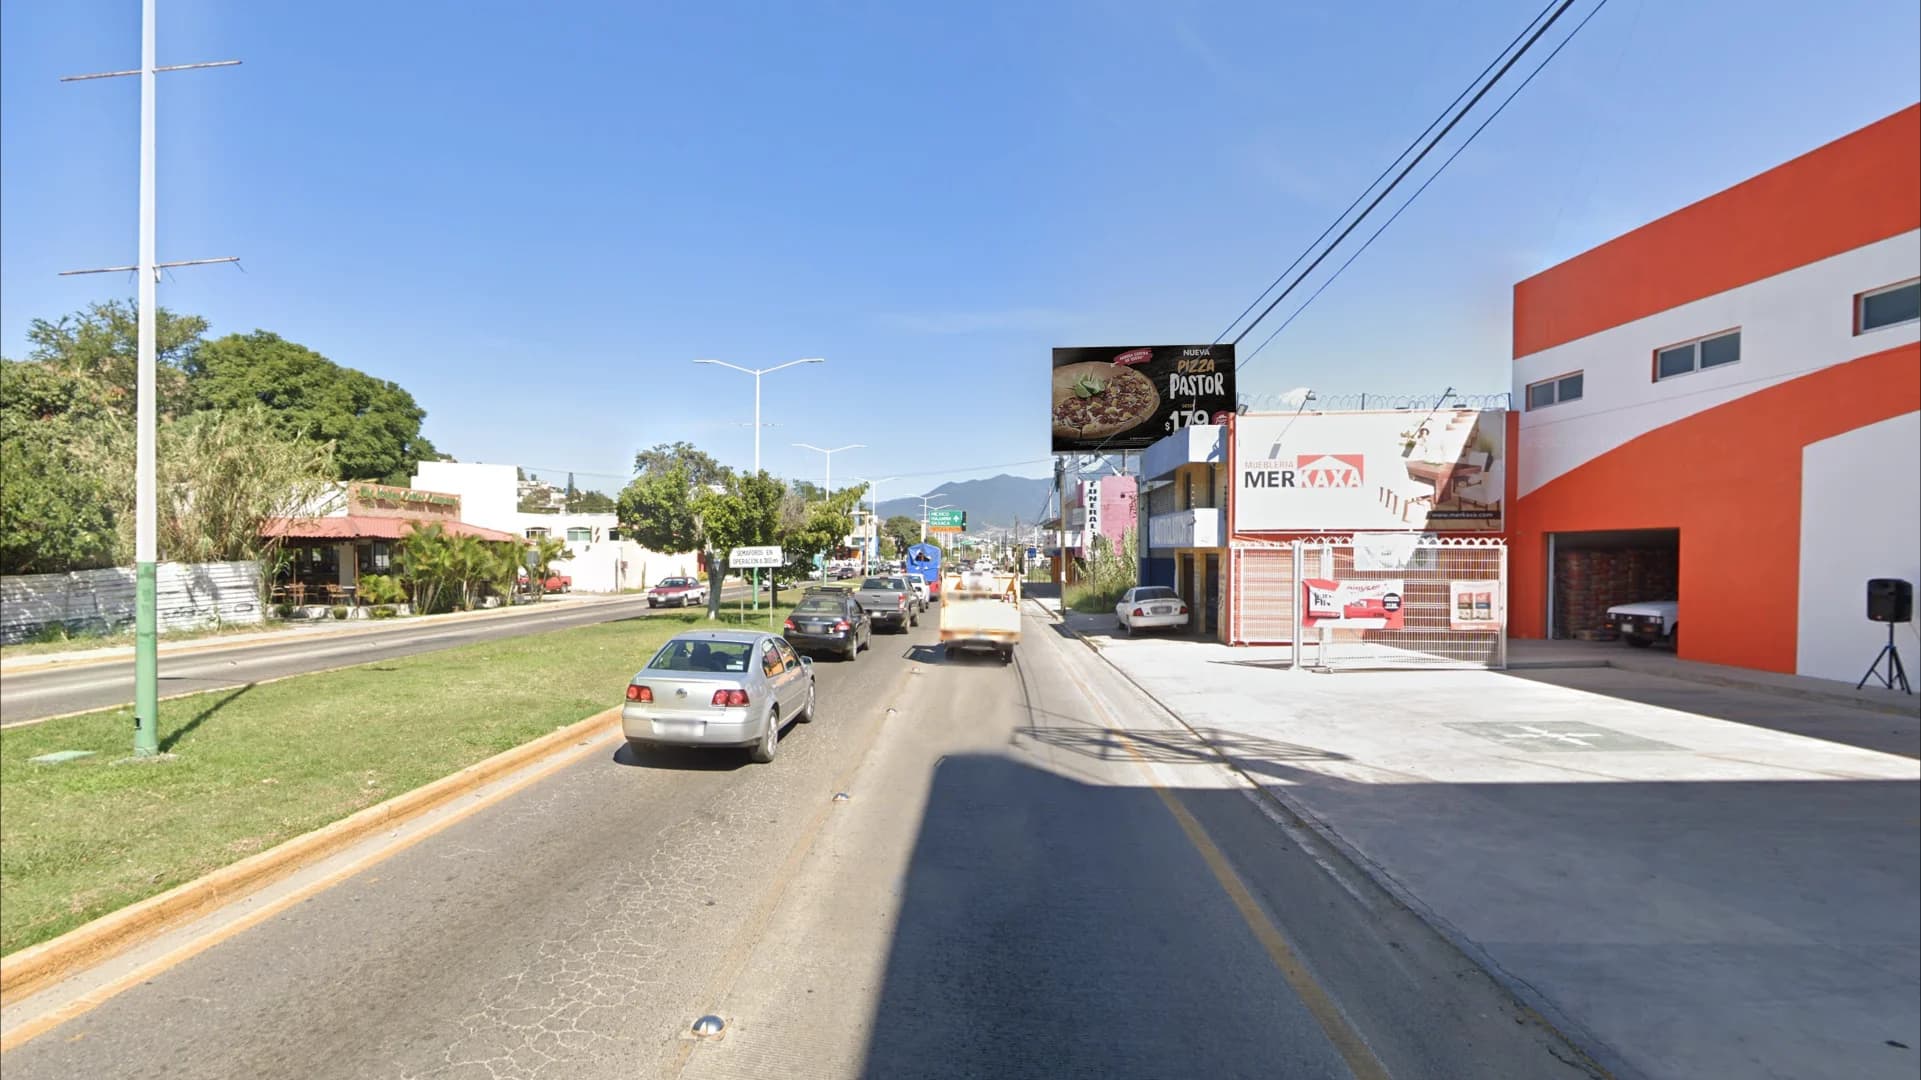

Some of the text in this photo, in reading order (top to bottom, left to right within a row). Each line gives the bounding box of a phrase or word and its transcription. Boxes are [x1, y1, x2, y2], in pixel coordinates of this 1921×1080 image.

[1183, 348, 1211, 357] NUEVA
[1177, 358, 1215, 374] PIZZA
[1169, 372, 1225, 400] PASTOR
